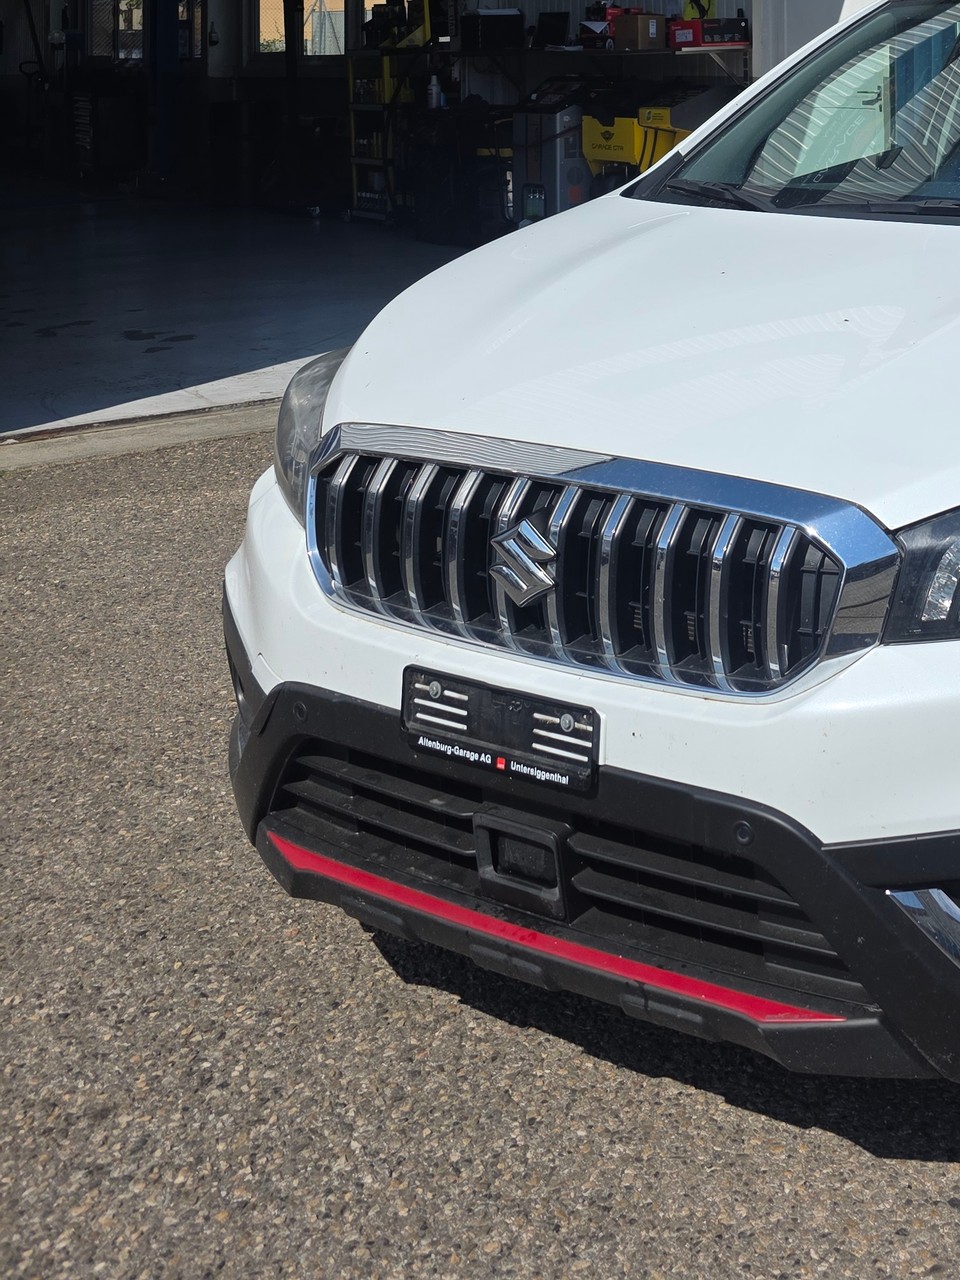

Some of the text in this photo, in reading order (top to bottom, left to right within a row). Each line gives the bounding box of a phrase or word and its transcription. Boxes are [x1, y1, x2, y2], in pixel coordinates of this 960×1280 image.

[418, 735, 569, 785] Altenburg-Garage AG Untersiggenthal
